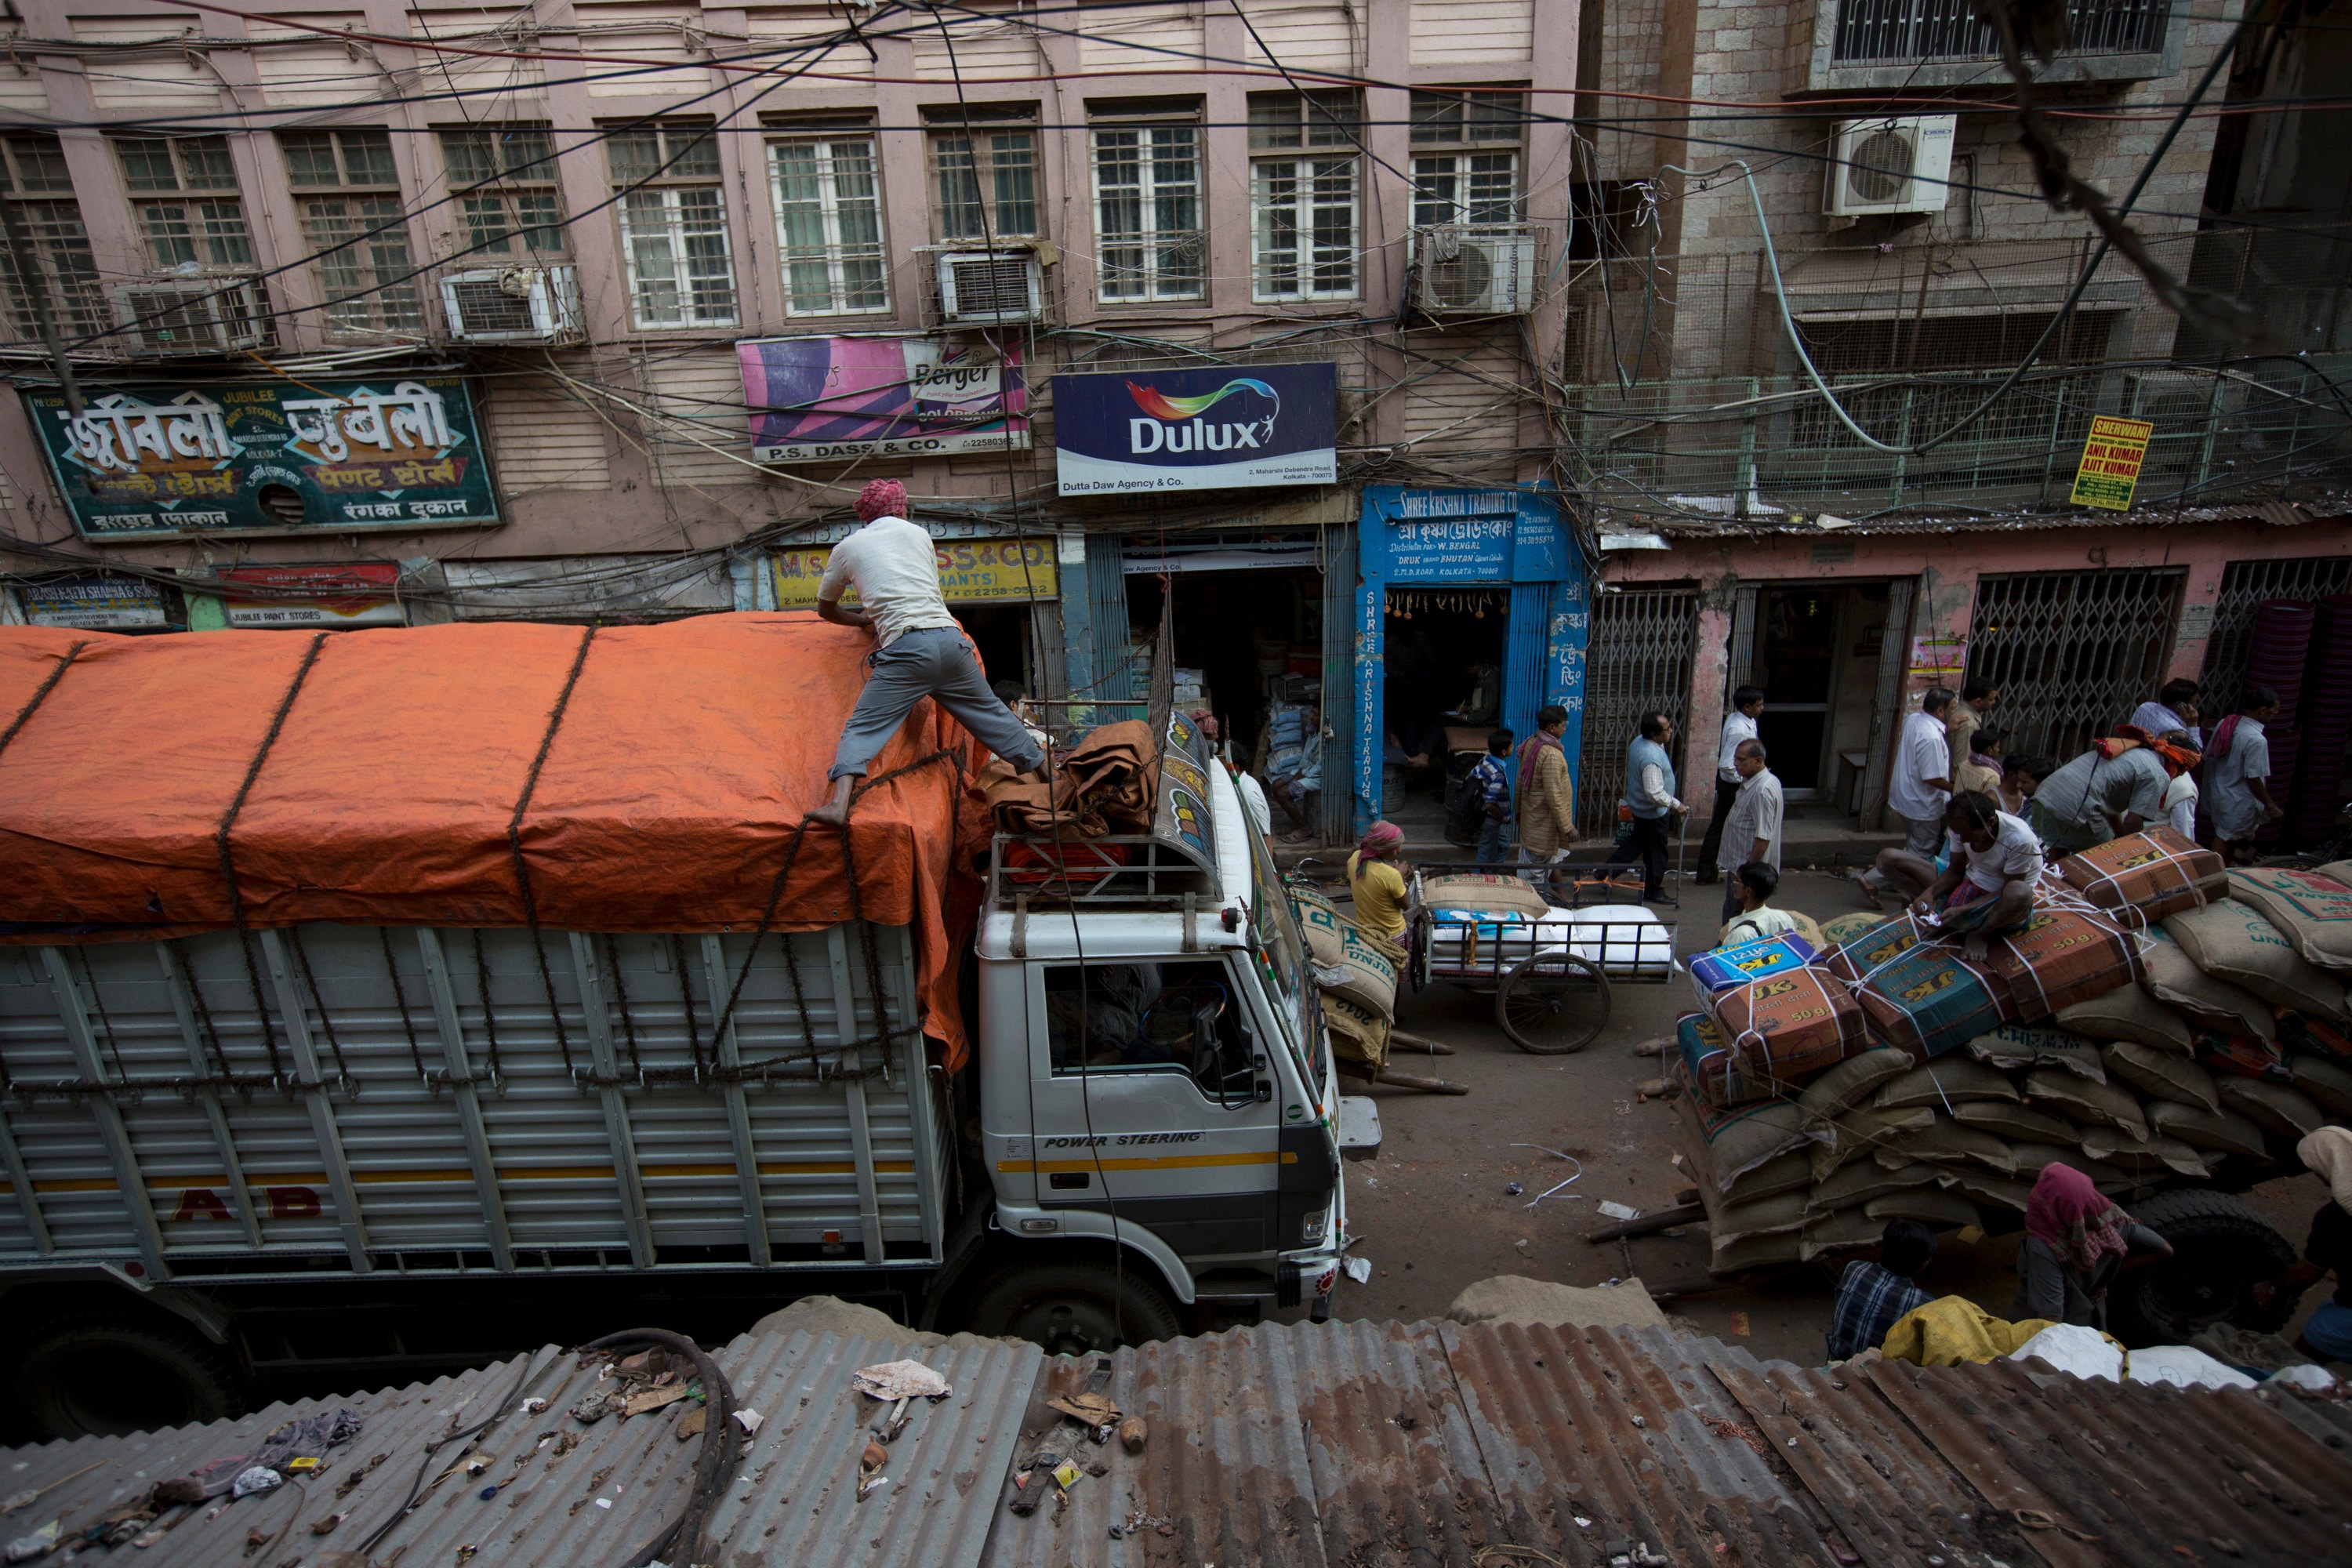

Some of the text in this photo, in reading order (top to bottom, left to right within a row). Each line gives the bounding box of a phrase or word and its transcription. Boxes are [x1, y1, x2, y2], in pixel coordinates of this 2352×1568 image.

[1507, 245, 1519, 293] Electrolux
[916, 364, 993, 390] Berger
[222, 390, 277, 404] JUBILEE
[225, 405, 285, 429] PAINT STORES
[1130, 417, 1261, 454] Dulux
[2094, 419, 2149, 440] SHERWANI
[768, 438, 946, 459] P.S. DASS & CO.
[2086, 444, 2143, 463] ANIL KUMAR
[2082, 458, 2139, 477] AJIT KUMAR
[1063, 482, 1091, 492] Dutta
[1093, 481, 1115, 490] Daw
[1117, 478, 1155, 490] Agency
[1167, 477, 1185, 486] Co.
[1429, 491, 1465, 517] KRISHNA
[1468, 493, 1505, 514] TRADING
[1507, 492, 1519, 513] CO.
[159, 510, 230, 528] দোকান
[1449, 541, 1480, 550] BENGAL
[233, 611, 321, 622] JUBILEE PAINT STORES
[1361, 736, 1371, 799] TRADING
[2053, 937, 2077, 950] 50
[1736, 952, 1785, 972] JK
[1751, 978, 1798, 1001] JK
[1897, 968, 1958, 1004] JK
[1335, 998, 1374, 1026] 2012
[1790, 1007, 1813, 1023] 50
[1044, 1134, 1108, 1149] POWER
[1116, 1132, 1202, 1145] STEERING
[169, 1187, 322, 1221] A B
